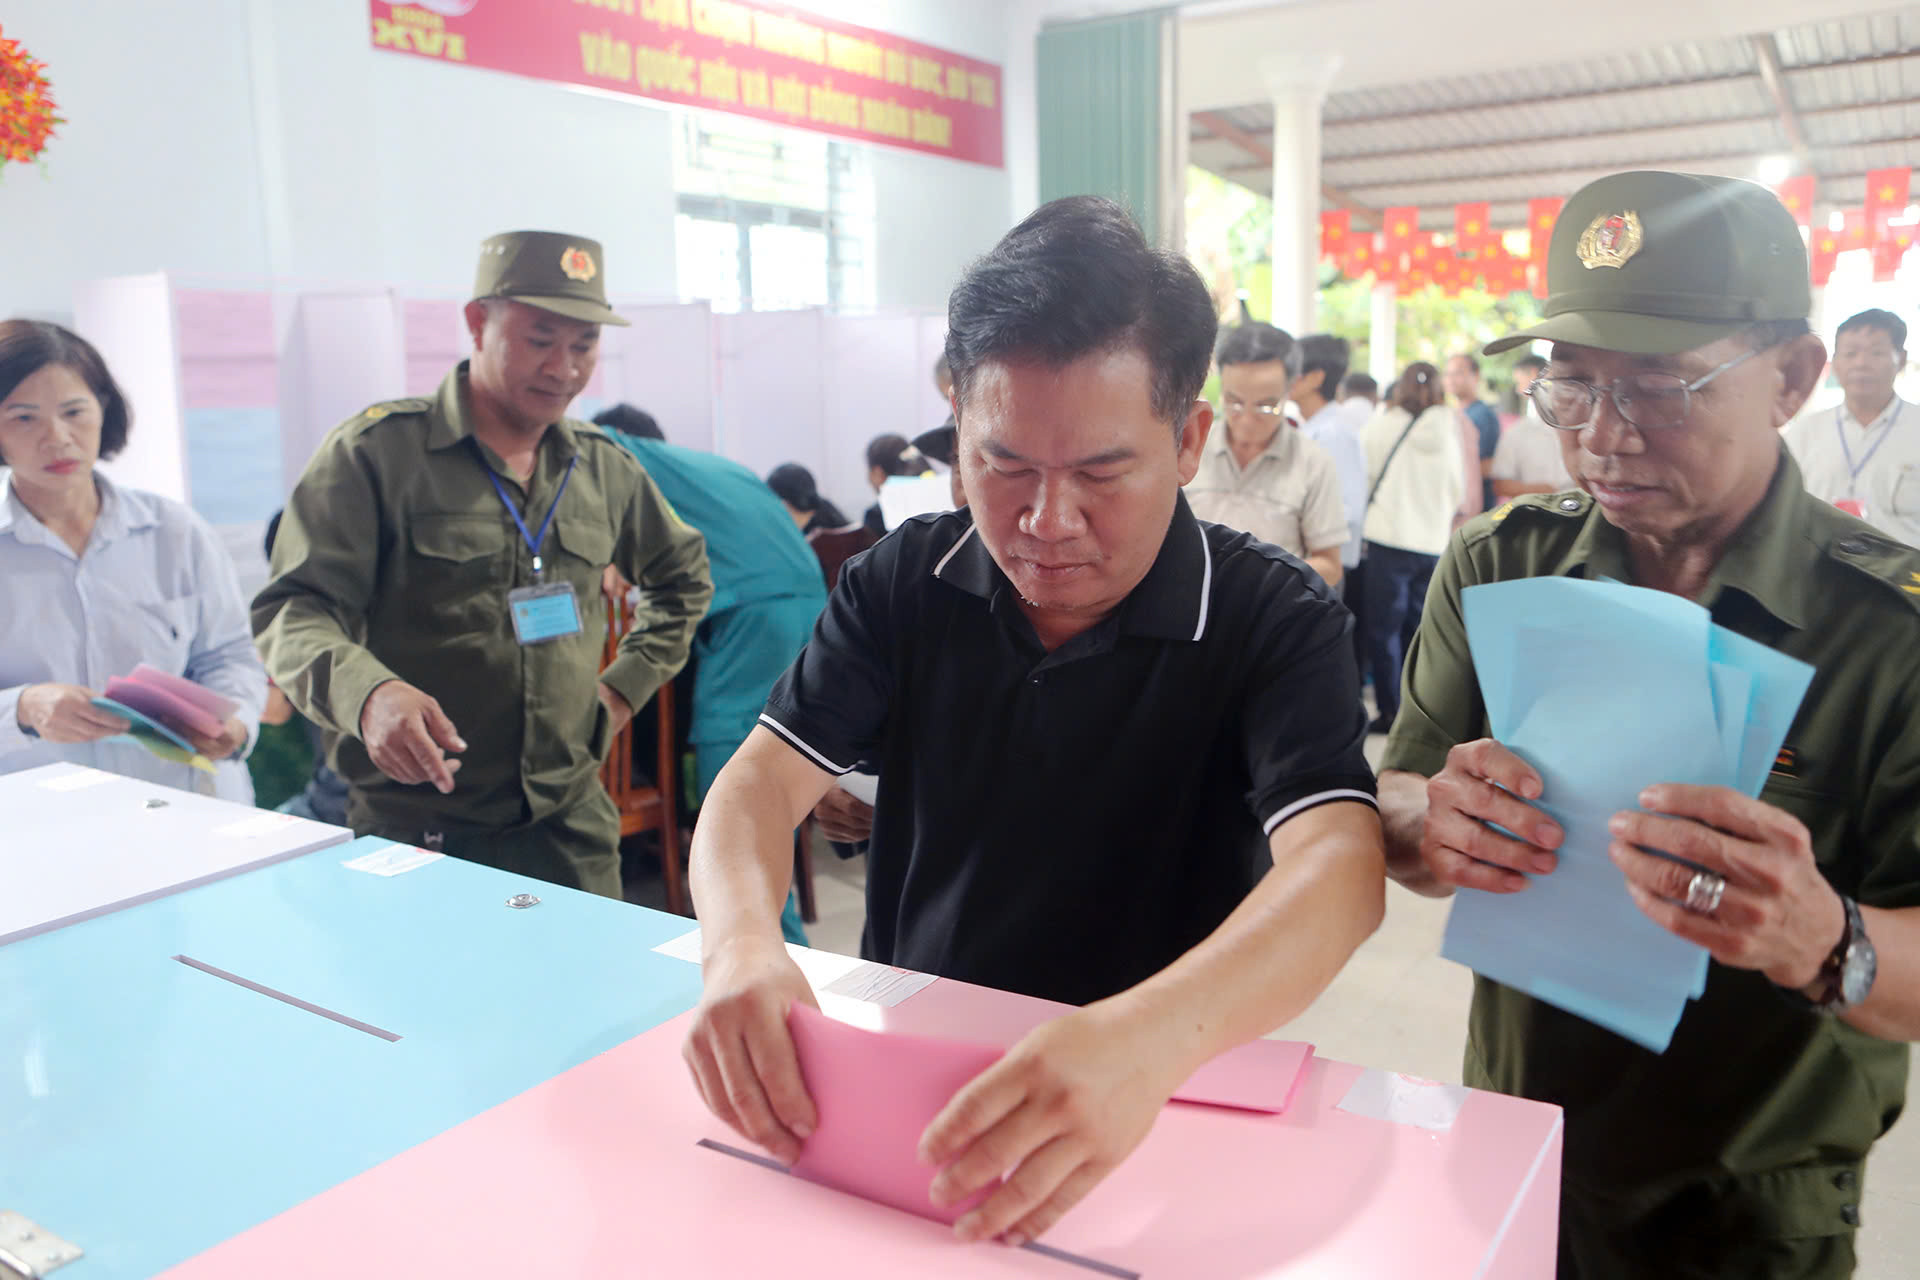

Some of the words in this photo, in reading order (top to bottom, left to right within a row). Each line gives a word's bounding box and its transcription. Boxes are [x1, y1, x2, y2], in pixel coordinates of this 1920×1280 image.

[373, 17, 467, 62] XVI
[578, 28, 633, 82] VÀO
[635, 41, 698, 95] QUỐC
[699, 57, 739, 107] HỘI
[740, 67, 769, 108] VÀ
[771, 75, 808, 122] HỘI
[808, 75, 859, 129] ĐỒNG
[861, 96, 911, 140] NHÂN
